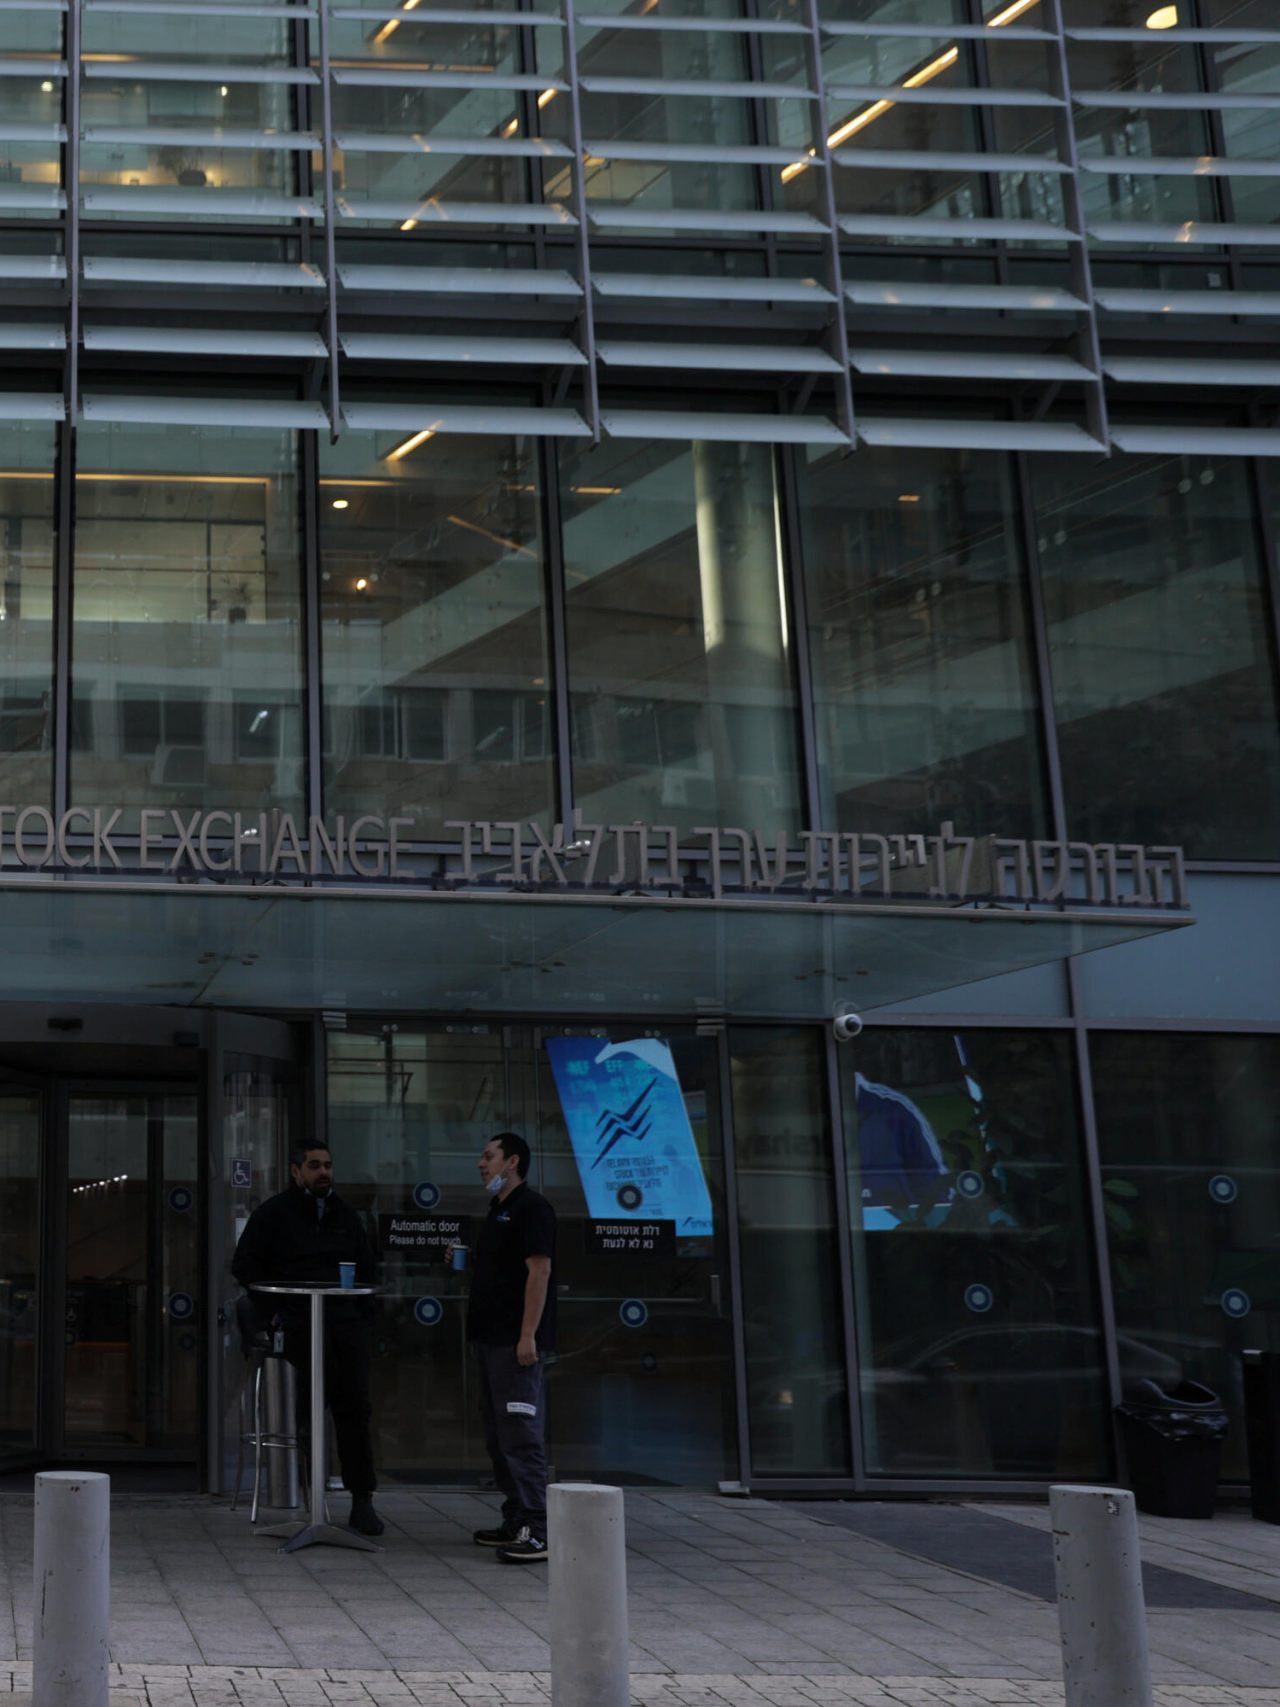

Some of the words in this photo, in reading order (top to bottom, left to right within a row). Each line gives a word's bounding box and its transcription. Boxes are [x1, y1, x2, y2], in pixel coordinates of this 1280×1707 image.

[139, 808, 416, 879] EXCHANGE
[390, 1218, 437, 1232] Automatic
[438, 1219, 461, 1232] door
[642, 1224, 660, 1236] דלת
[389, 1234, 415, 1246] Please
[416, 1235, 426, 1246] do
[427, 1236, 440, 1246] not
[441, 1235, 462, 1247] touch
[628, 1238, 640, 1249] לא
[643, 1239, 654, 1250] נא
